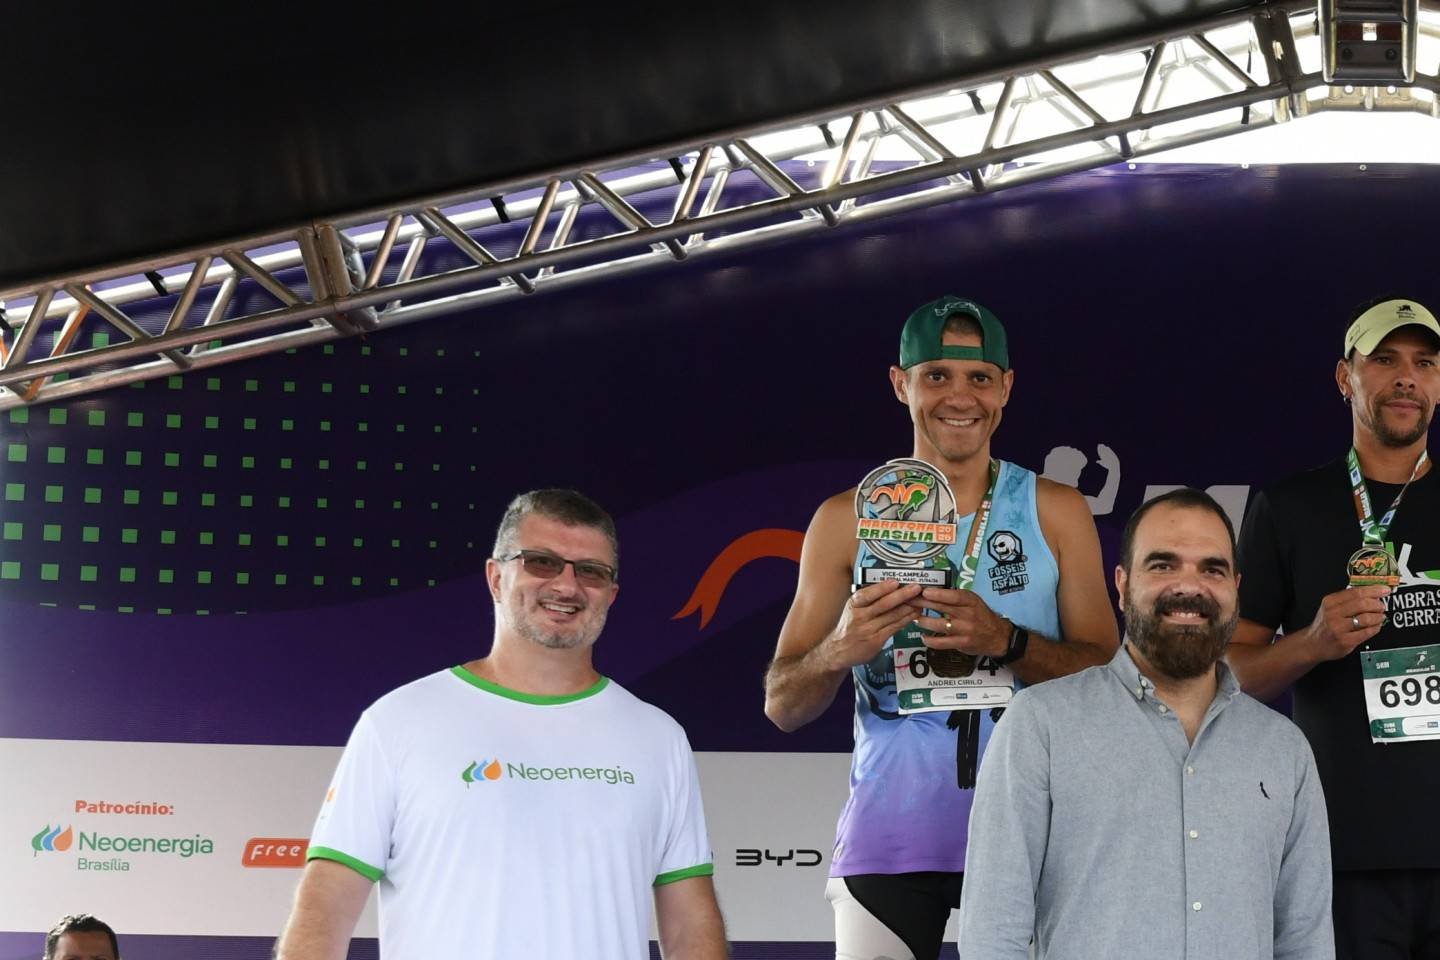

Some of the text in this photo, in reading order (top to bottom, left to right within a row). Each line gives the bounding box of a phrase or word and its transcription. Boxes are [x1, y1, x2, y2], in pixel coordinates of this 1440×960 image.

[993, 575, 1029, 590] ASFALTO
[507, 763, 635, 785] Neoenergia
[75, 799, 175, 816] Patrocínio:
[78, 832, 214, 858] Neoenergia
[77, 858, 130, 871] Brasília
[735, 848, 823, 867] BYD
